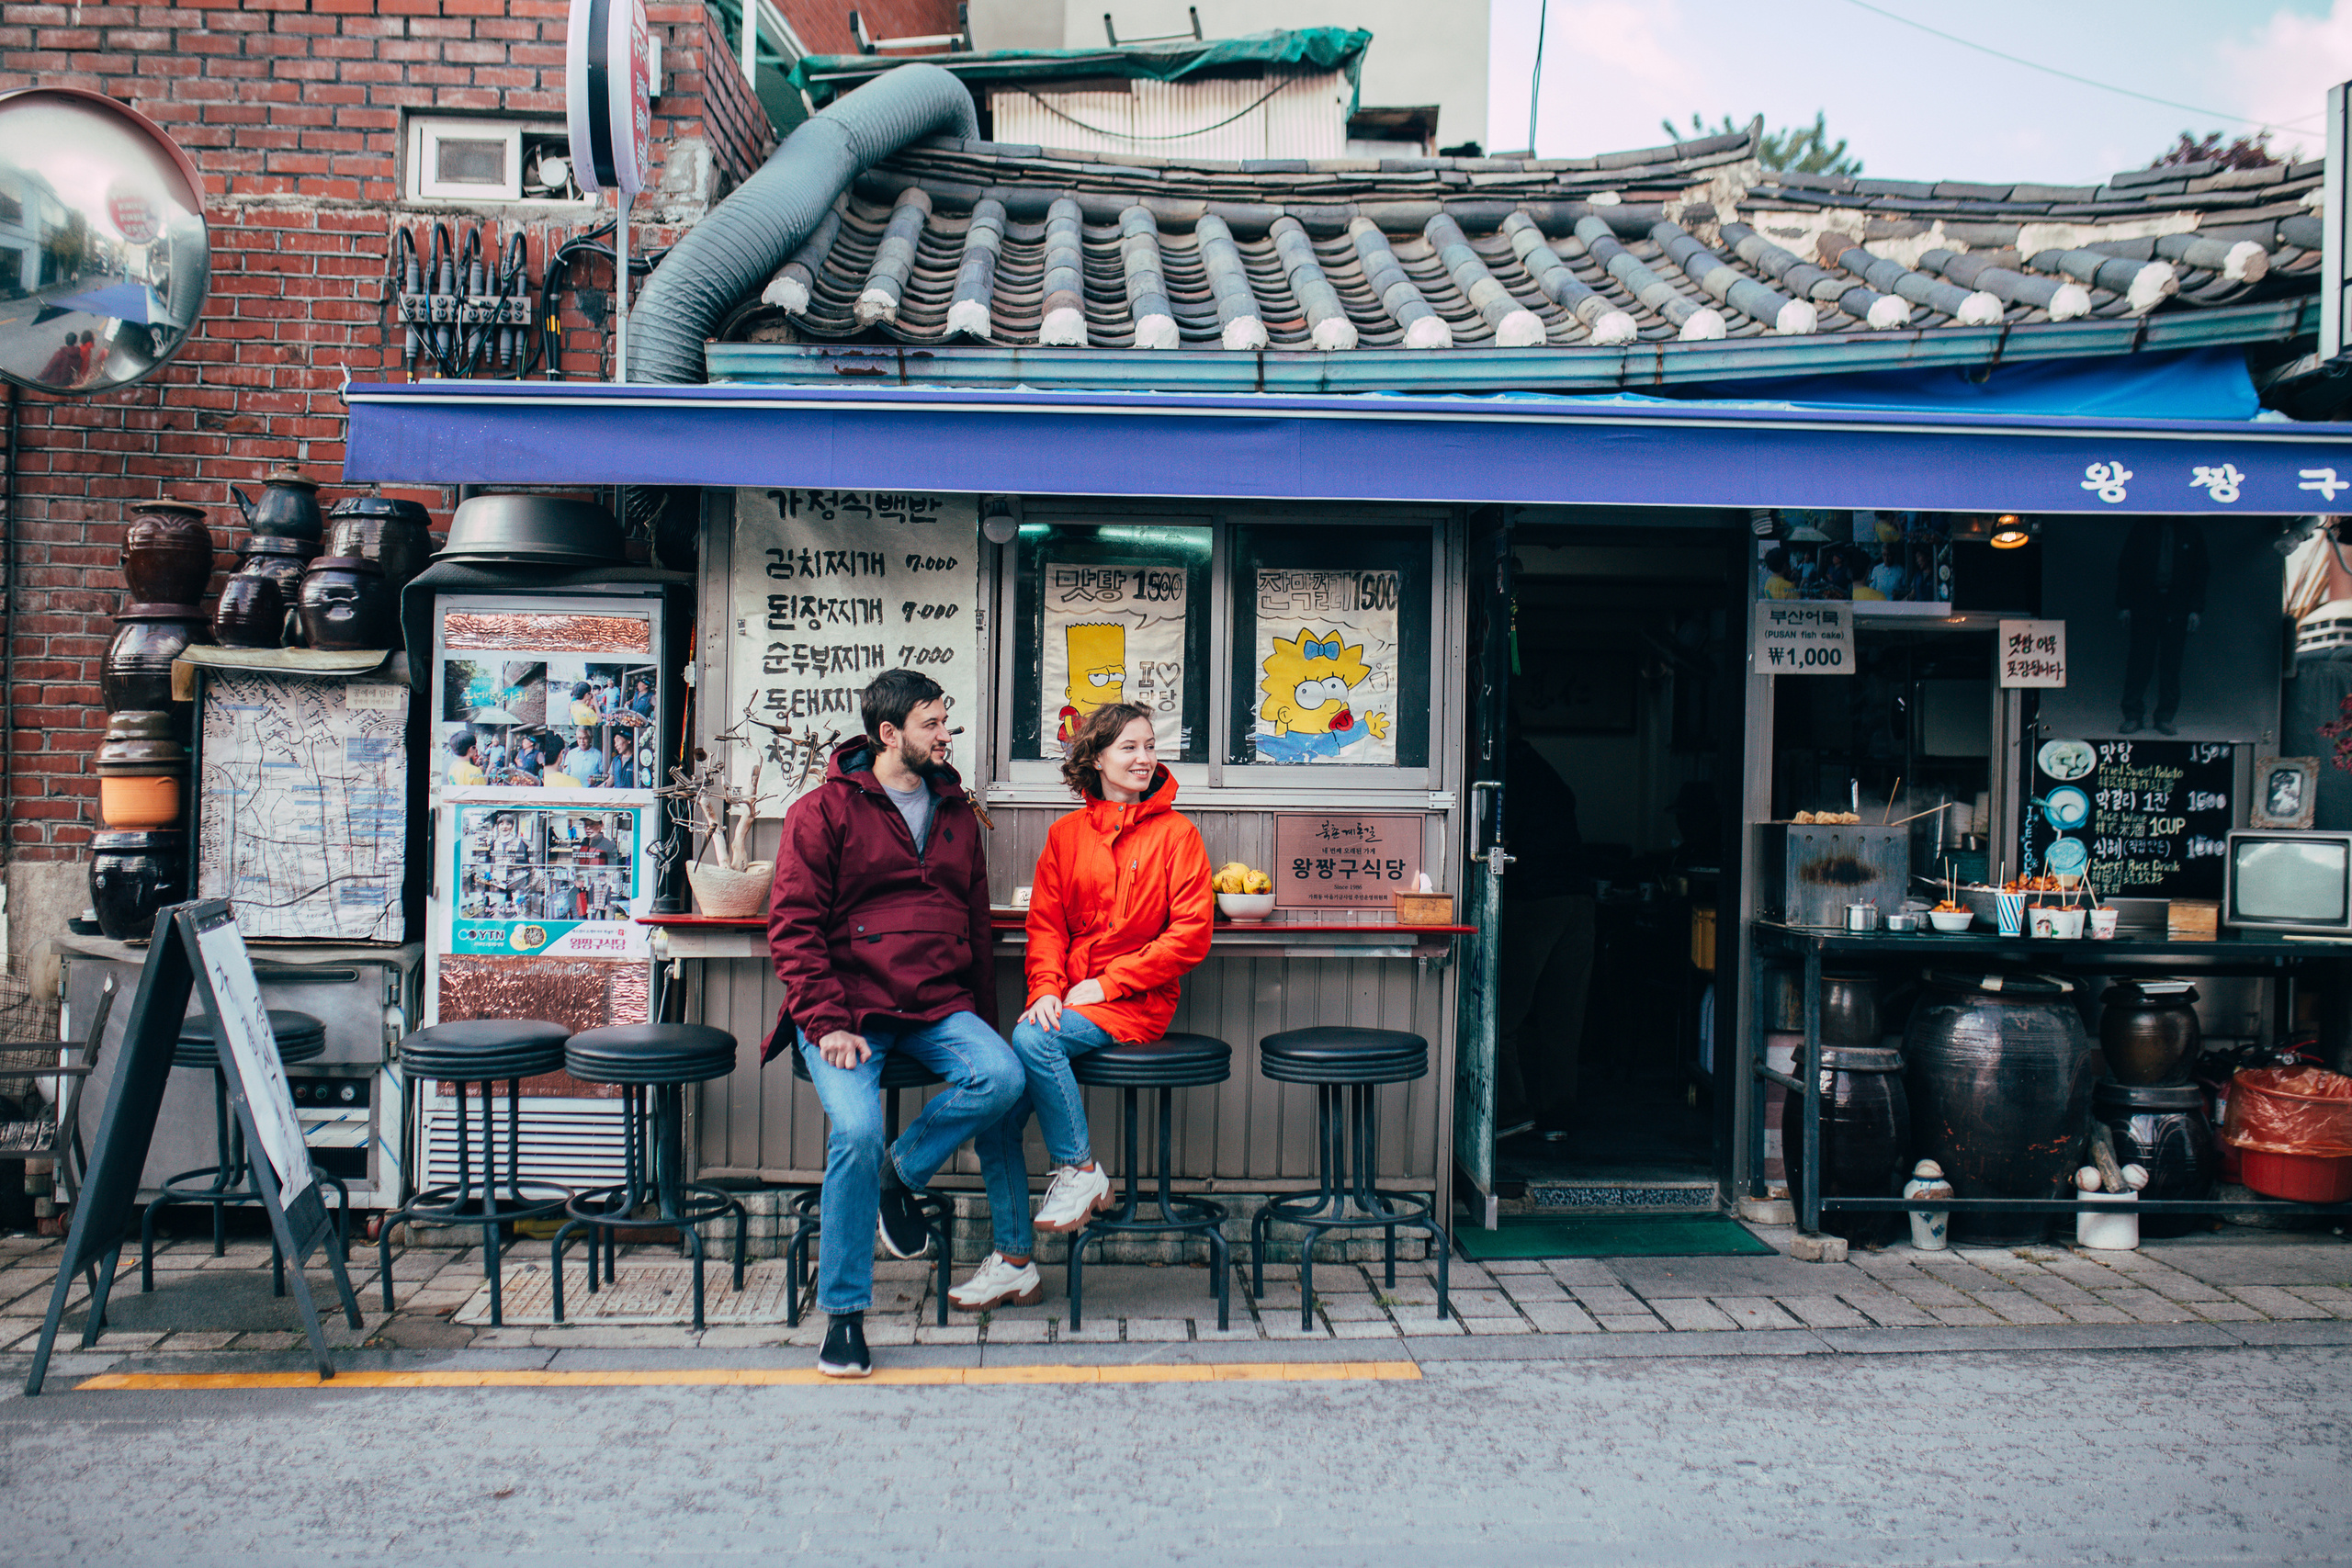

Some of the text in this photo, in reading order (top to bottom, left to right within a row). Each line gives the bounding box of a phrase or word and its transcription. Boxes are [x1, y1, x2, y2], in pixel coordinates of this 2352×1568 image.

[765, 548, 886, 580] 김치찌개
[1056, 569, 1182, 604] 맛탕 1500
[766, 593, 884, 631] 된장찌개
[1770, 610, 1839, 626] 부산어묵
[1764, 630, 1845, 640] (PUSAN fish cake)
[763, 641, 885, 679] 순두부찌개
[1768, 647, 1842, 669] ₩1,000
[763, 688, 867, 719] 동태찌
[2099, 741, 2134, 763] 맛탕
[2096, 788, 2137, 812] 막걸리
[2096, 809, 2120, 822] Rice
[2149, 817, 2187, 838] 1CUP
[1292, 858, 1407, 881] 왕짱구식당
[2127, 859, 2151, 871] Rice
[479, 931, 505, 942] YTN
[570, 937, 627, 951] 왕짱구식당
